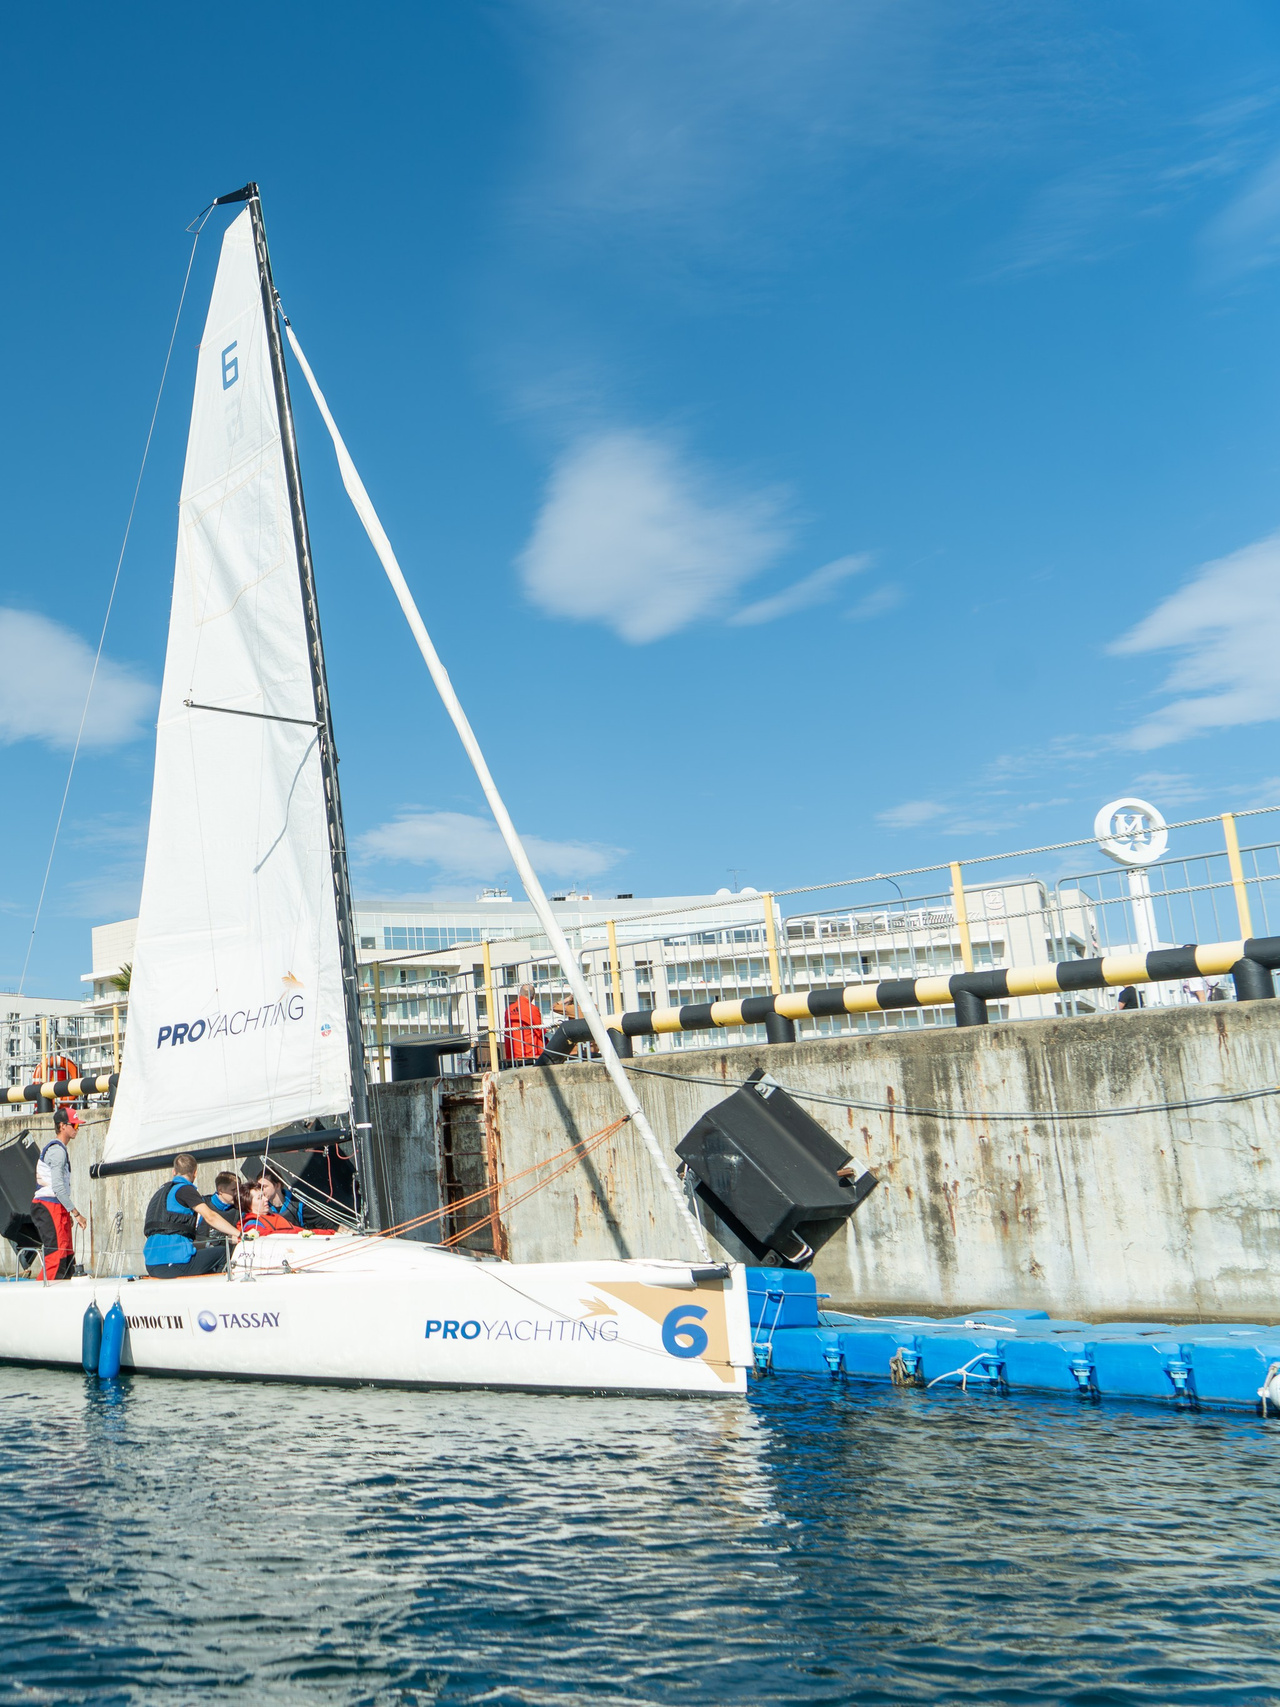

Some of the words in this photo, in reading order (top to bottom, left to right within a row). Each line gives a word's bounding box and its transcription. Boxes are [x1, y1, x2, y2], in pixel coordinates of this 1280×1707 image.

[222, 340, 238, 391] 6
[157, 994, 304, 1049] PROYACHTING
[124, 1315, 184, 1331] ДОМОСТИ
[219, 1312, 280, 1329] TASSAY
[424, 1319, 619, 1342] PROYACHTING
[661, 1303, 709, 1359] 6
